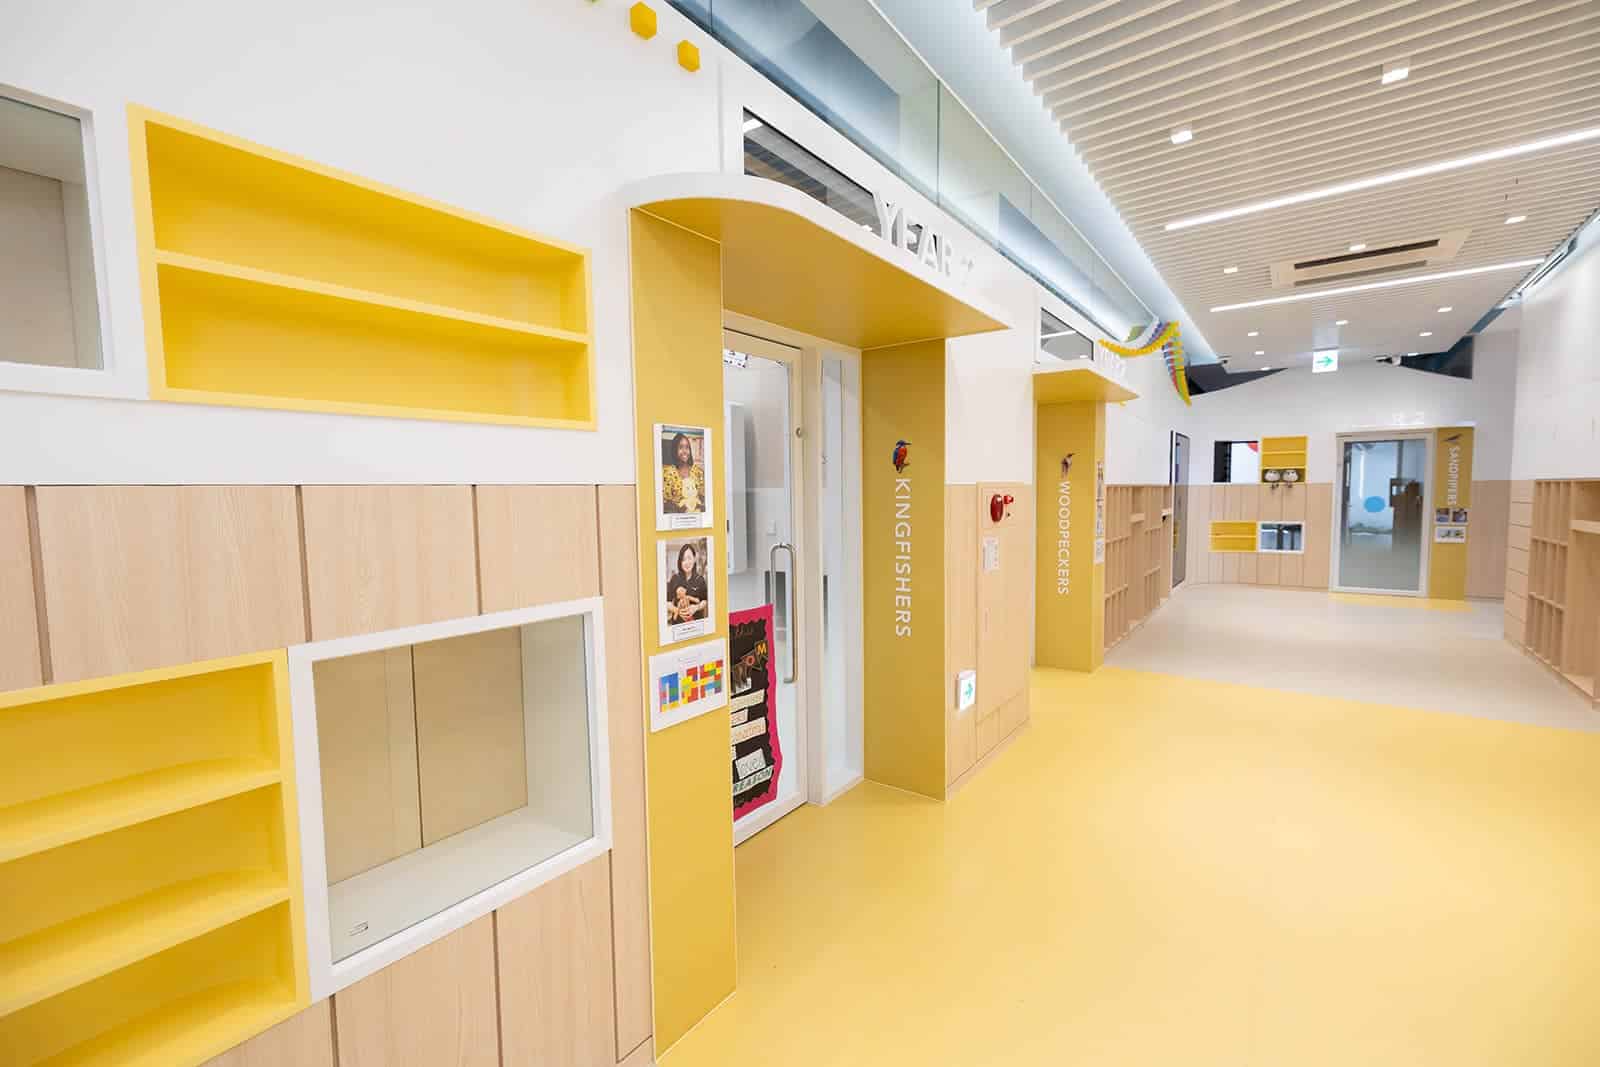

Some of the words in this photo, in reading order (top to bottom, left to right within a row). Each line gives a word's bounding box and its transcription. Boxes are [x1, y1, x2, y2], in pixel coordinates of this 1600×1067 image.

[872, 191, 953, 279] YEAR
[895, 478, 912, 638] KINGFISHERS
[1057, 481, 1072, 595] WOODPECKERS
